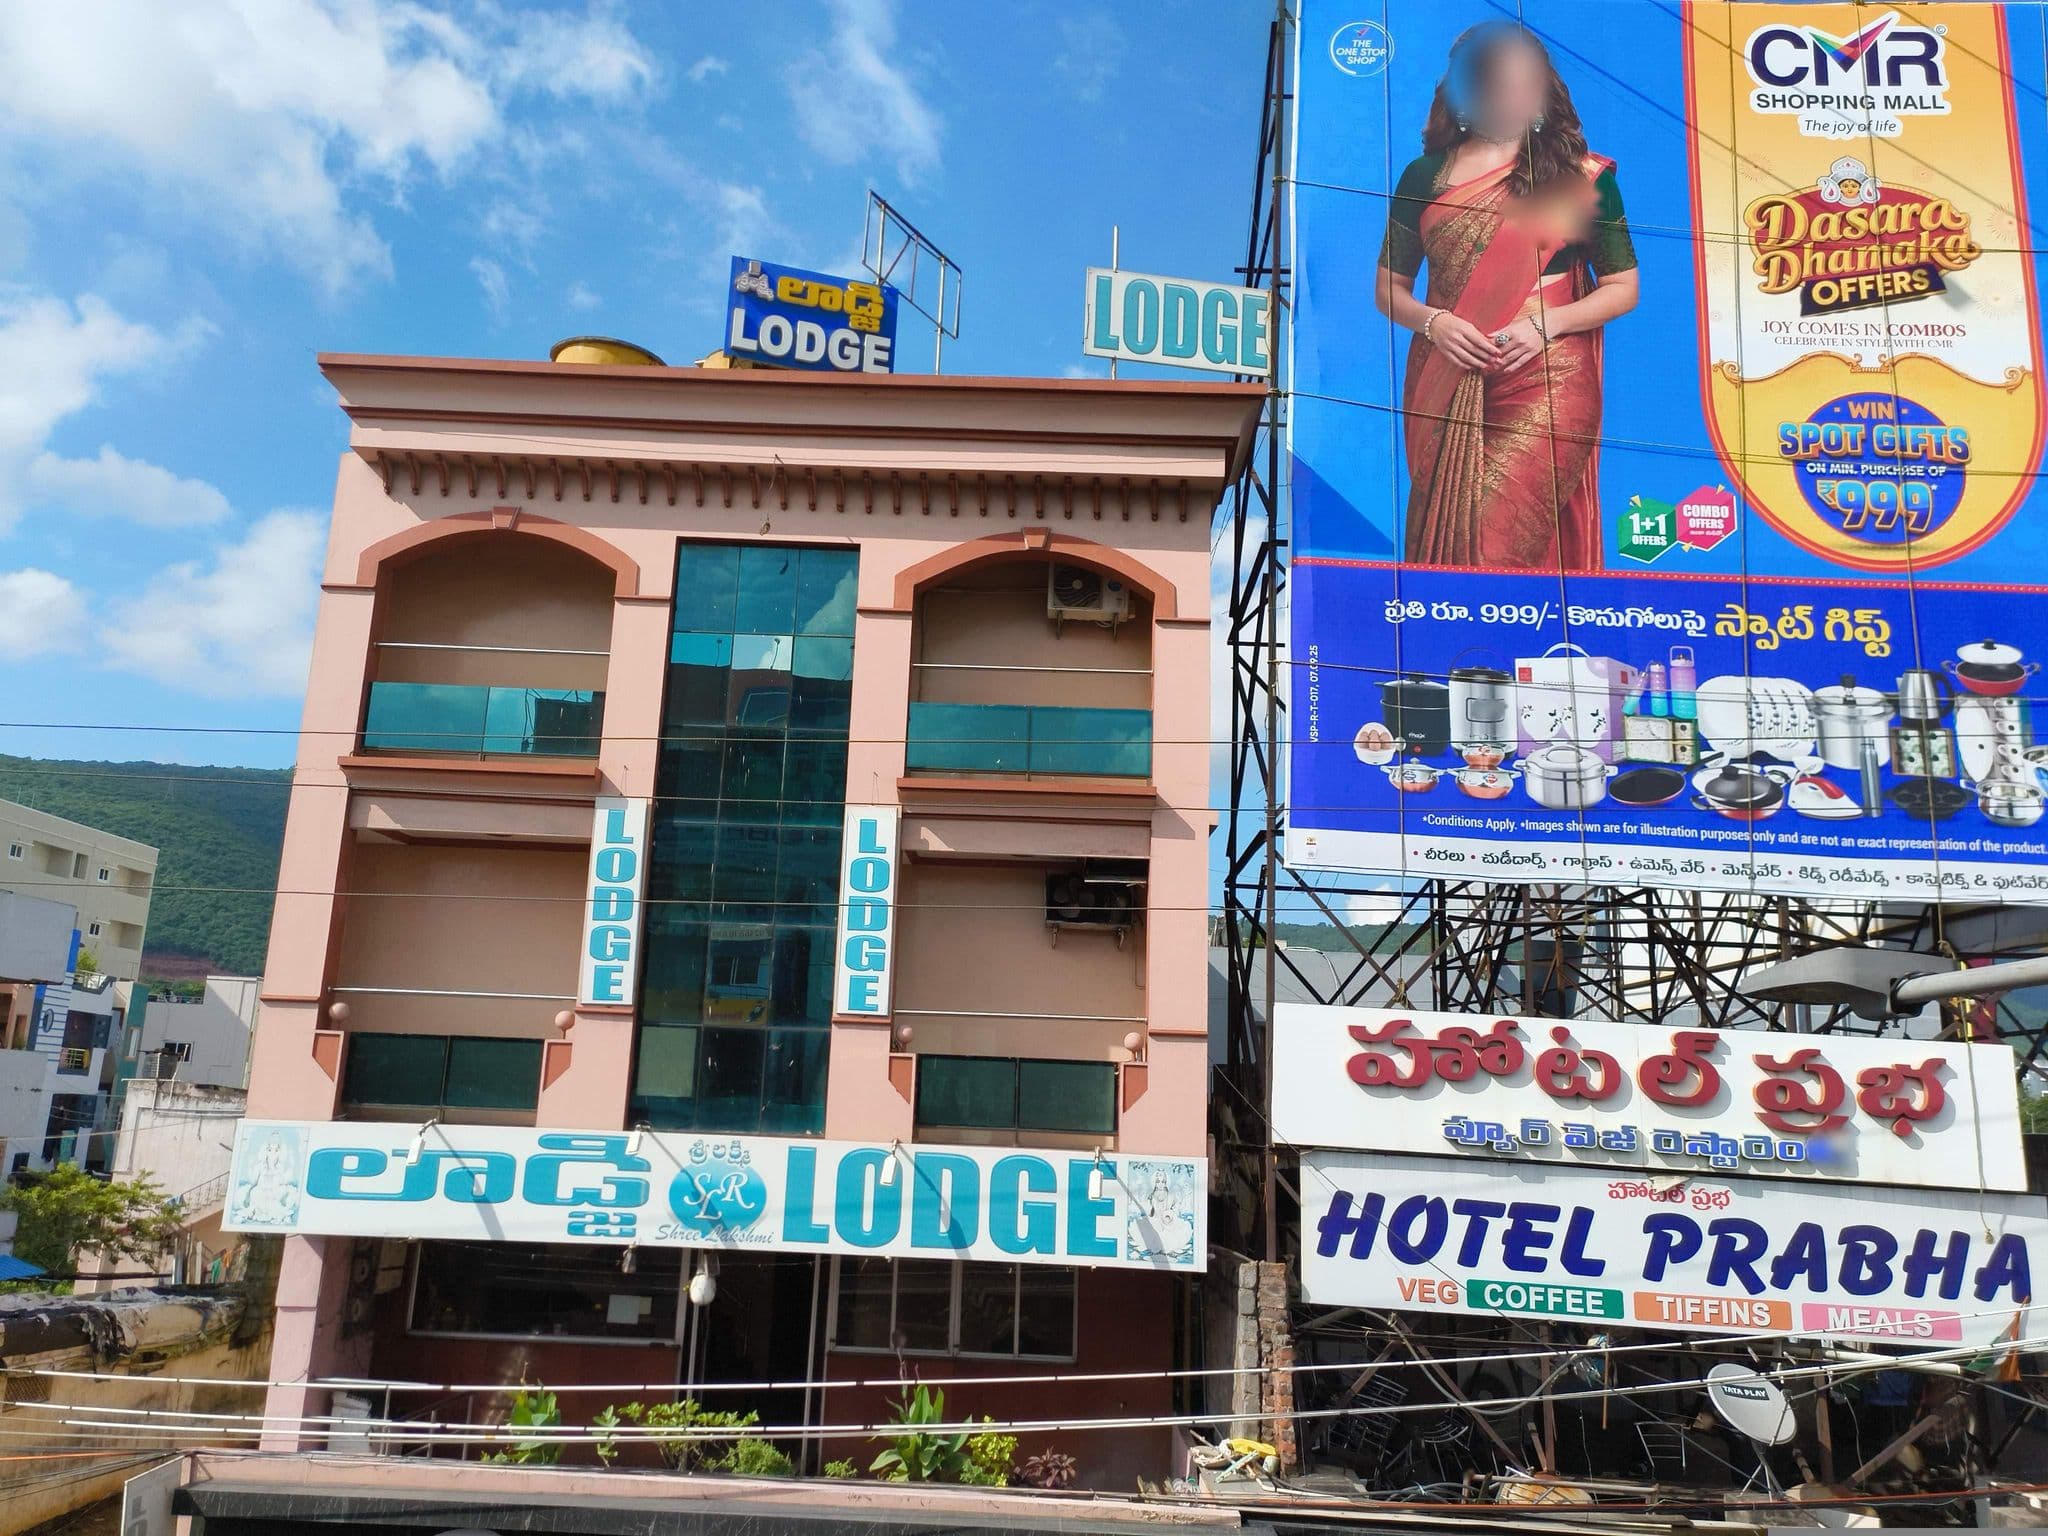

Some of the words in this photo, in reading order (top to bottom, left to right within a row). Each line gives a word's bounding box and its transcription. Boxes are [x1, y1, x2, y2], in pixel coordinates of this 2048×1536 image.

[1336, 47, 1358, 56] ONE
[1360, 48, 1387, 57] STOP
[1352, 39, 1372, 48] THE
[1751, 17, 1943, 87] CMR
[1347, 56, 1376, 65] SHOP
[1756, 93, 1876, 110] SHOPPING
[1884, 95, 1945, 110] MALL
[1805, 120, 1830, 132] The
[1832, 120, 1855, 134] joy
[1858, 120, 1873, 132] of
[1876, 120, 1897, 132] life
[1743, 195, 1970, 249] Dasara
[1753, 230, 1981, 294] Dhamaka
[1811, 268, 1930, 306] OFFERS
[1093, 275, 1269, 370] LODGE
[1761, 321, 1793, 334] JOY
[1798, 321, 1859, 336] COMES
[1865, 322, 1882, 336] IN
[1887, 323, 1966, 337] COMBOS
[730, 307, 891, 373] LODGE
[1774, 336, 1838, 346] CELEBRATE
[1841, 338, 1852, 347] IN
[1856, 338, 1891, 348] STYLE
[1893, 339, 1924, 348] WITH
[1927, 340, 1953, 348] CMR
[1848, 401, 1894, 420] WIN
[1779, 422, 1866, 459] SPOT
[1873, 424, 1972, 464] GIFTS
[1806, 462, 1826, 474] ON
[1829, 463, 1858, 475] MIN.
[1861, 464, 1924, 476] PURCHASE
[1928, 465, 1947, 476] OF
[1629, 512, 1667, 535] 1+1
[1682, 504, 1729, 519] COMBO
[1688, 518, 1724, 529] OFFERS
[1632, 535, 1667, 546] OFFERS
[1385, 599, 1426, 623] ప్రతి
[1431, 601, 1474, 622] రూ.
[1567, 605, 1708, 637] కొనుగోలుపై
[1715, 603, 1814, 650] స్పాట్
[1824, 607, 1891, 658] గిఫ్ట్
[1486, 817, 1517, 833] Apply.
[1566, 820, 1601, 833] shown
[1603, 824, 1620, 834] are
[1623, 823, 1638, 834] for
[1640, 823, 1698, 838] illustration
[1700, 828, 1750, 842] purposes
[1752, 830, 1775, 845] only
[1778, 831, 1798, 844] and
[1800, 834, 1819, 845] are
[1821, 835, 1838, 846] not
[1841, 837, 1855, 847] an
[1857, 837, 1886, 848] exact
[1969, 838, 1981, 851] of
[1983, 839, 2001, 852] the
[2003, 841, 2048, 855] product.
[1974, 873, 1987, 887] &
[589, 808, 637, 1001] LODGE
[845, 819, 890, 1011] LODGE
[1346, 1019, 1721, 1108] హోటల్
[1752, 1048, 1947, 1137] ప్రభ
[1562, 1122, 1637, 1151] వెజ్
[782, 1145, 1118, 1258] LODGE
[1691, 1186, 1731, 1210] ప్రభ
[655, 1224, 700, 1241] Shree
[705, 1225, 774, 1243] Lakshmi
[1317, 1190, 1606, 1277] HOTEL
[1642, 1212, 2031, 1304] PRABHA
[1398, 1277, 1459, 1304] VEG
[1484, 1283, 1605, 1315] COFFEE
[1656, 1296, 1771, 1327] TIFFINS
[1827, 1307, 1932, 1337] MEALS
[1723, 1386, 1743, 1395] TATA
[1744, 1389, 1766, 1397] PLAY
